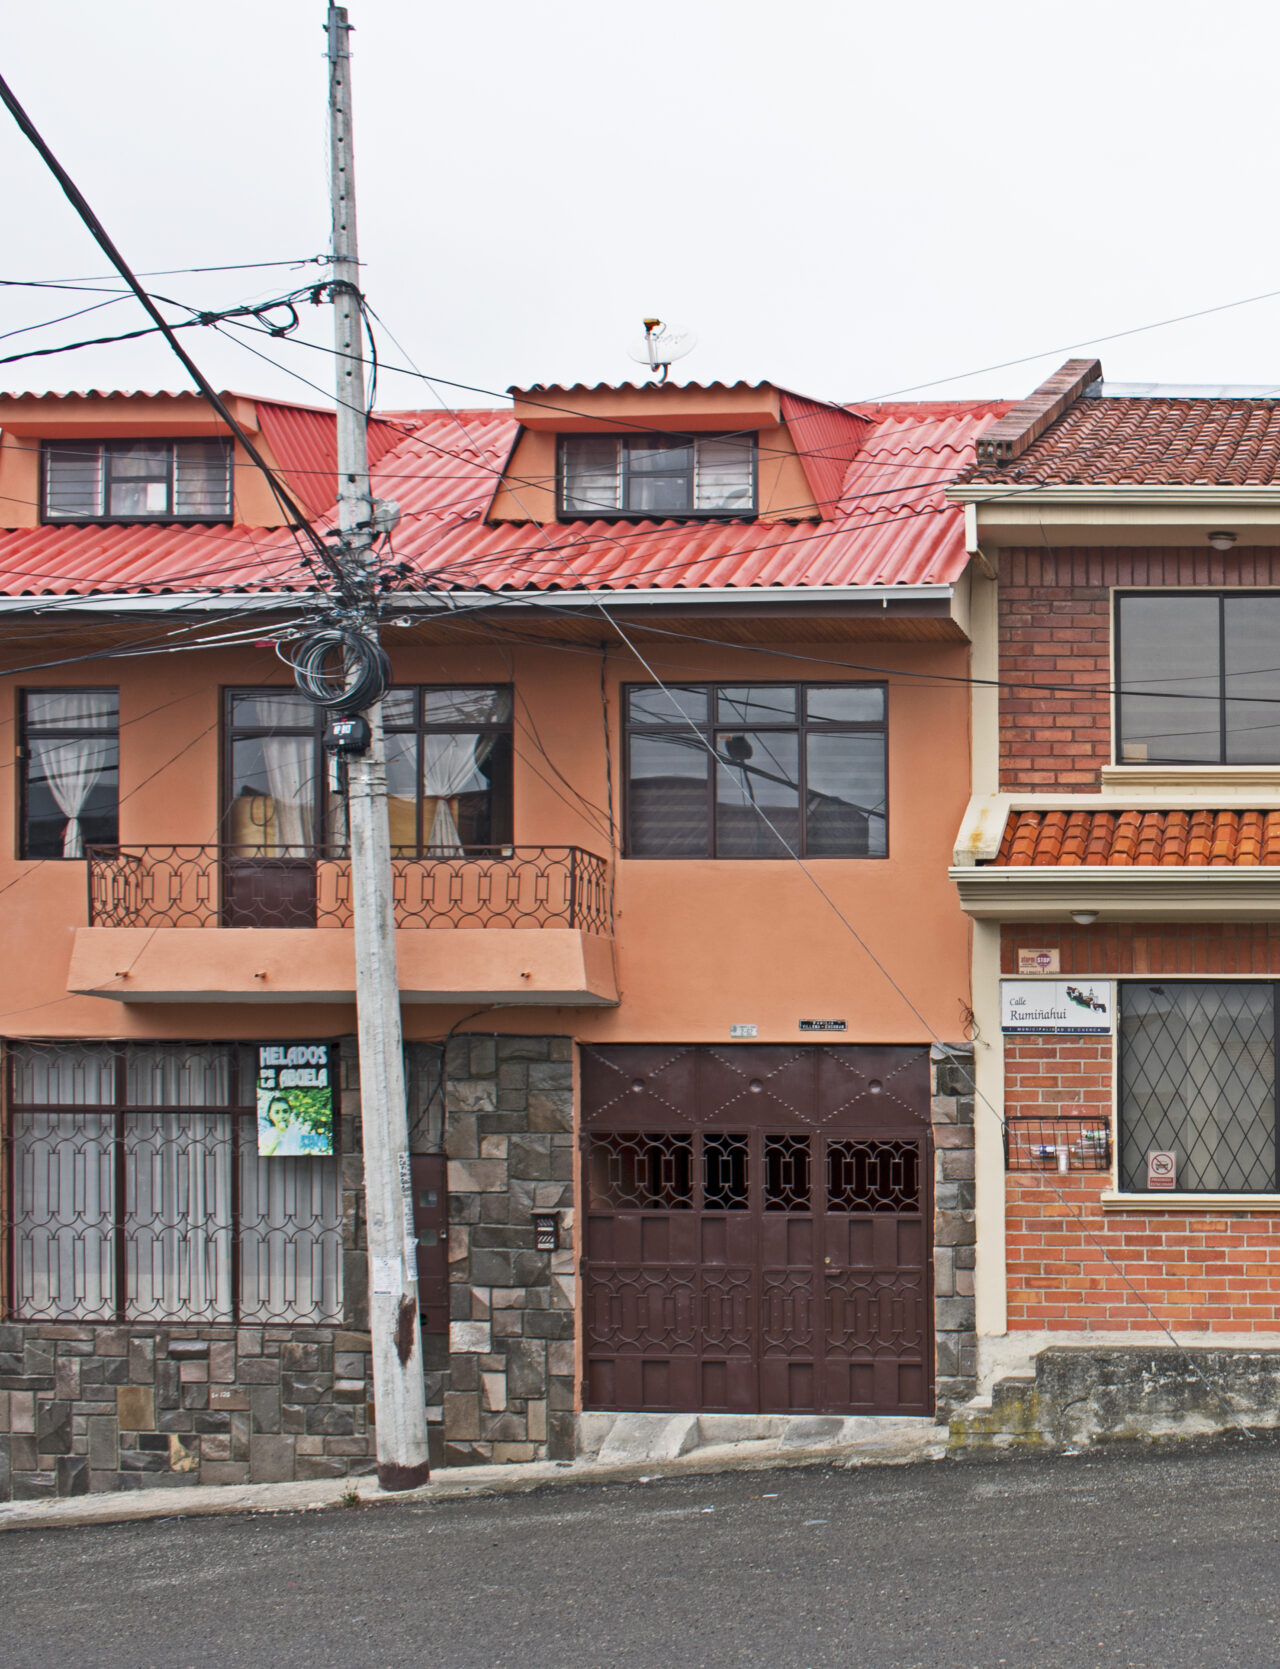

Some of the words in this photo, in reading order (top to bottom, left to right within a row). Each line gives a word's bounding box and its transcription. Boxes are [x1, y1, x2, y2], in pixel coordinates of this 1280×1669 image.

[1009, 996, 1026, 1006] Calle
[1010, 1008, 1067, 1021] Rumiñahui
[259, 1046, 328, 1067] HELADOS
[260, 1069, 276, 1078] DE
[279, 1068, 328, 1089] ABUELA
[260, 1079, 276, 1088] LA
